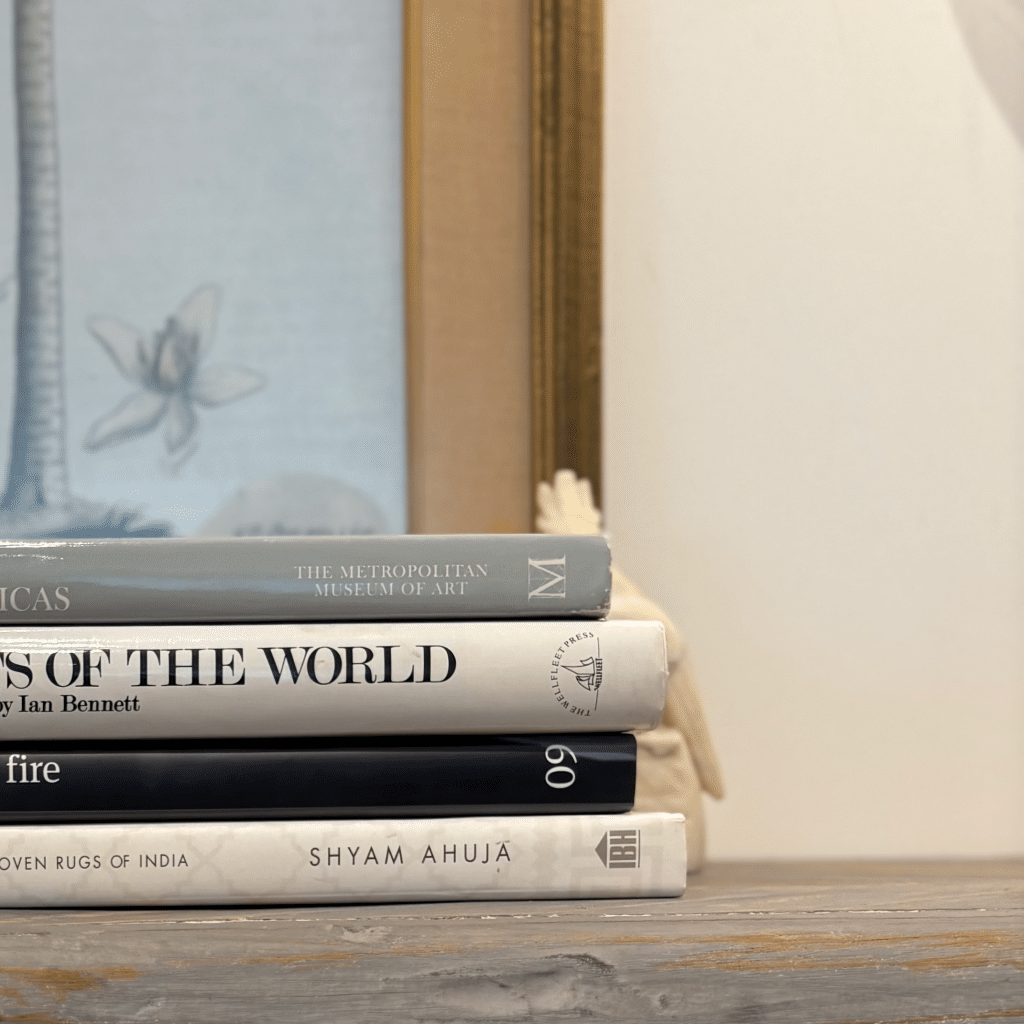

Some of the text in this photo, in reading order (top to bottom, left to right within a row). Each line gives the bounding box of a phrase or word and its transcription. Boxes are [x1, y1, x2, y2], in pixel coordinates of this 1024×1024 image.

[294, 564, 488, 579] THE METROPOLITAN
[314, 581, 469, 597] MUSEUM OF ART
[45, 649, 111, 688] OF
[126, 647, 246, 687] THE
[257, 645, 457, 685] WORLD
[550, 631, 594, 717] THE WELLFLEET PRESS
[18, 695, 54, 713] Ian
[60, 695, 141, 713] Bennett
[6, 754, 60, 783] fire
[309, 842, 511, 867] SHYAM AHUJA
[609, 829, 637, 869] IBH
[56, 855, 102, 870] RUGS
[110, 854, 130, 869] OF
[139, 854, 189, 868] INDIA
